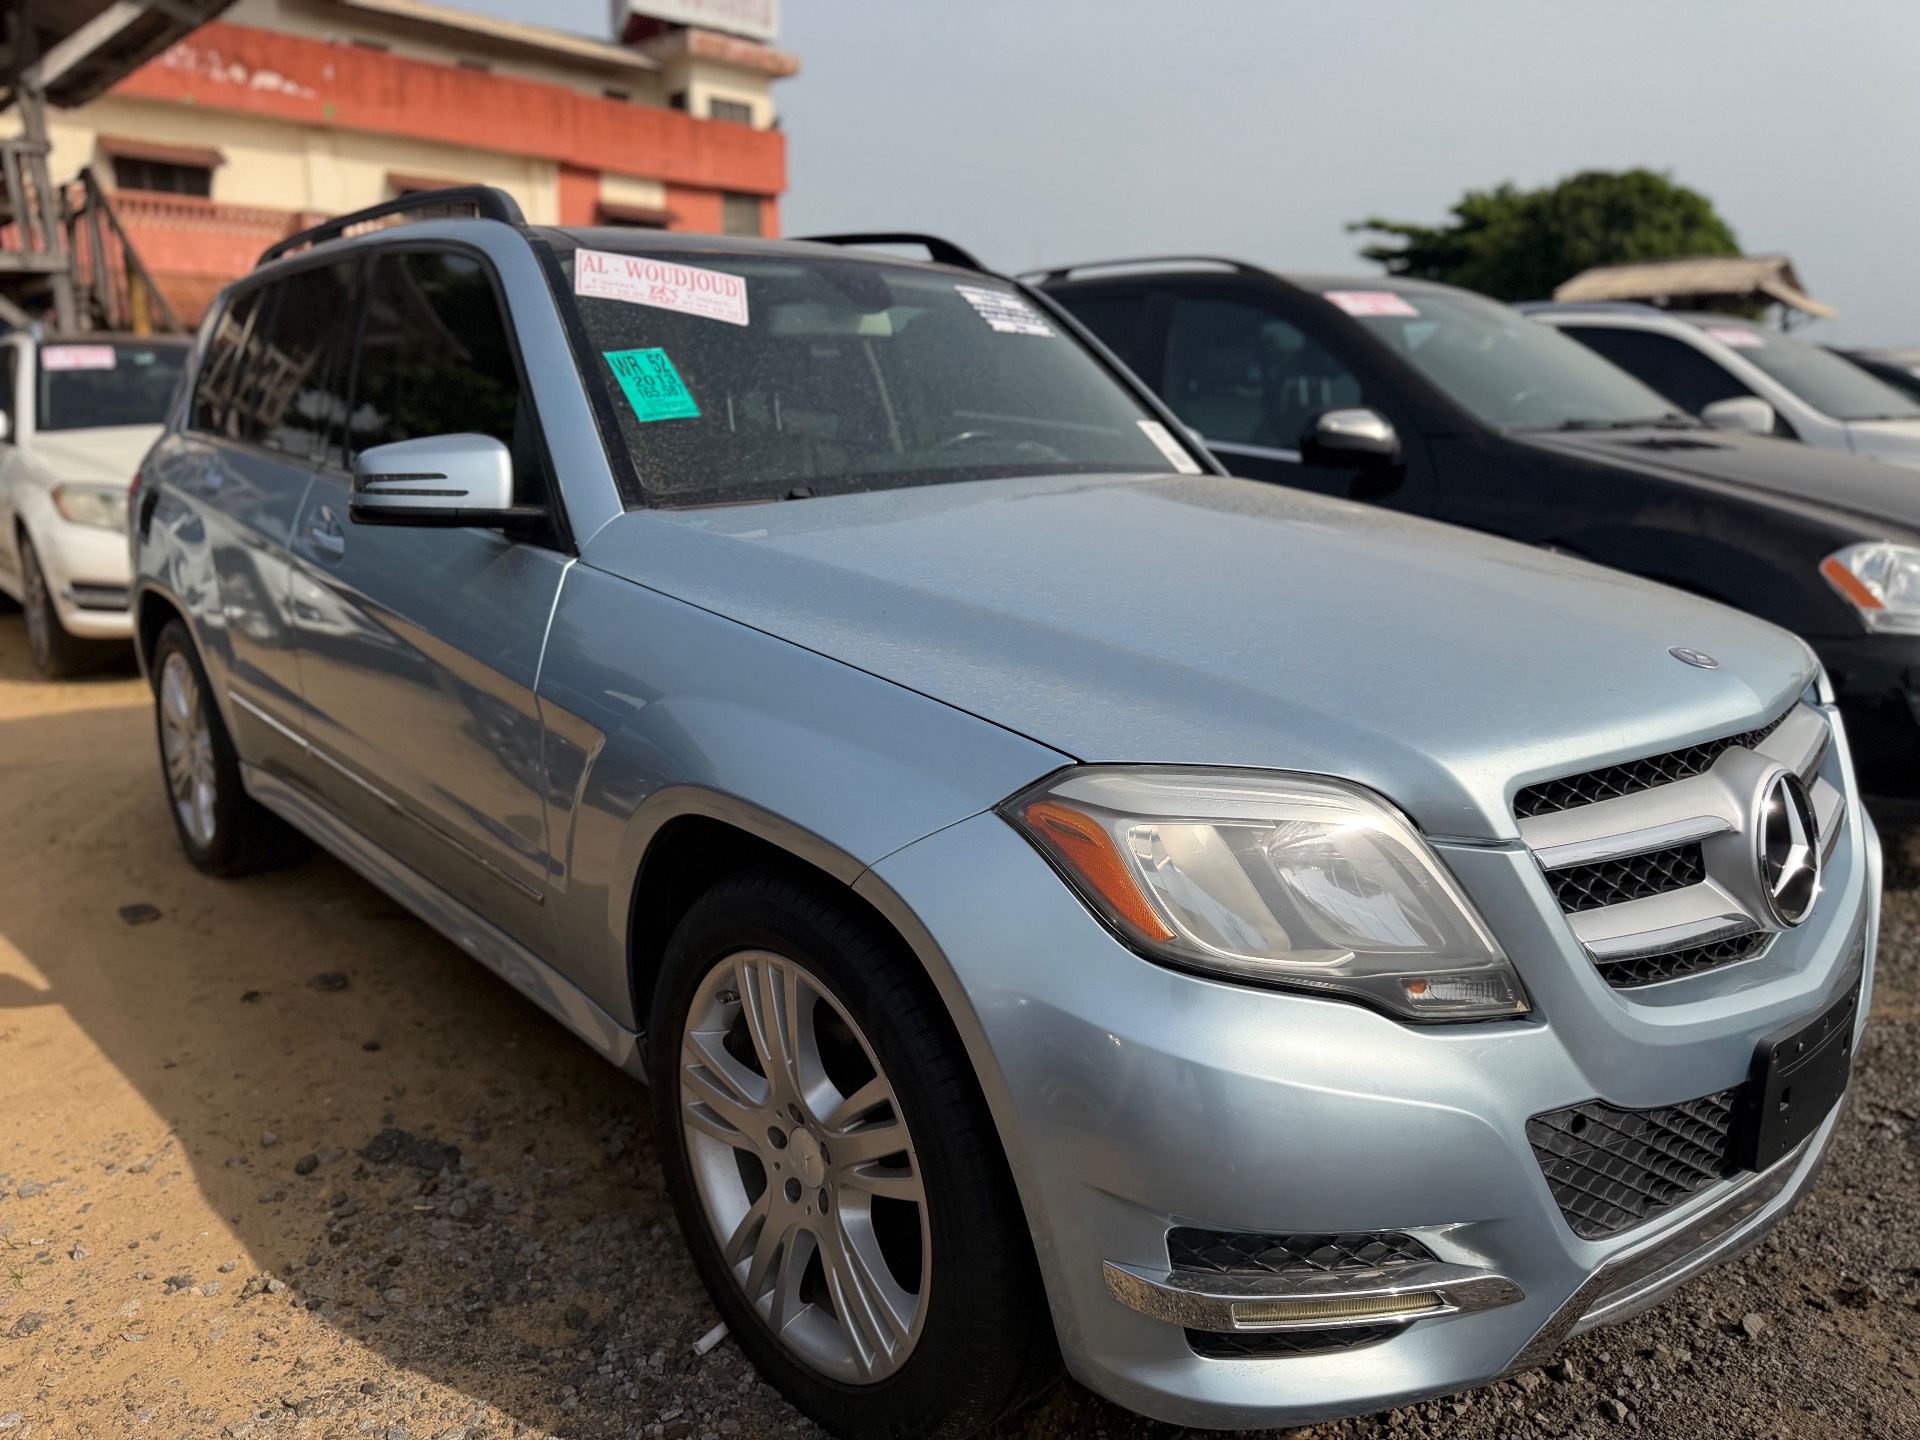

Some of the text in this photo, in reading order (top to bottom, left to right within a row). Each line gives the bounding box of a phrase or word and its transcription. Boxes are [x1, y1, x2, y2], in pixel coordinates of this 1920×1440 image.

[583, 255, 608, 274] AL
[625, 260, 737, 297] WOUDJOUD
[611, 353, 671, 377] WR 52
[633, 374, 676, 387] 2013
